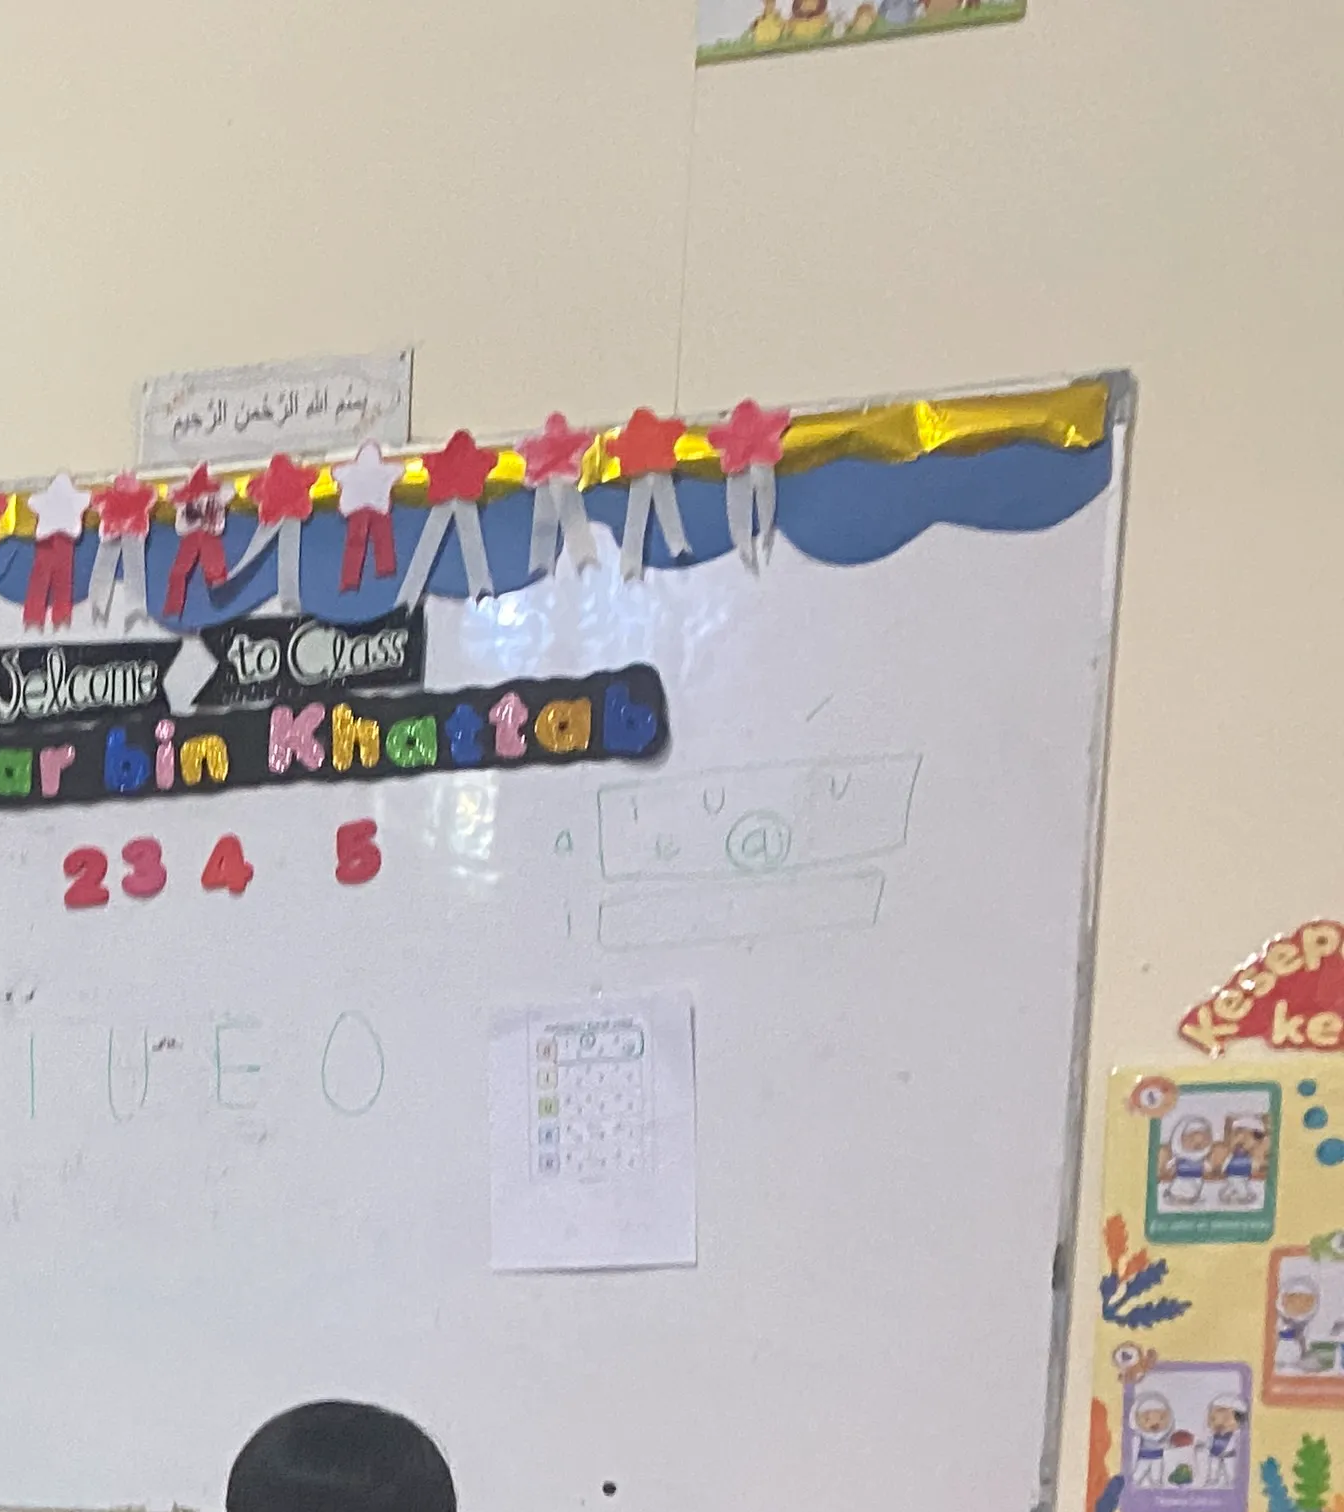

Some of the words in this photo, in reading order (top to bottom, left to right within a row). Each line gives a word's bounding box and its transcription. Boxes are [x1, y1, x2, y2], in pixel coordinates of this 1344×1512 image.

[227, 632, 281, 685] to
[287, 619, 409, 686] Class
[103, 718, 230, 796] bin
[267, 682, 659, 775] Khattab
[63, 846, 110, 910] 2
[121, 836, 167, 899] 3
[201, 832, 254, 896] 4
[335, 817, 382, 885] 5
[1181, 924, 1344, 1050] Kesep
[107, 1025, 150, 1123] U
[214, 1011, 263, 1110] E
[320, 1008, 386, 1118] O
